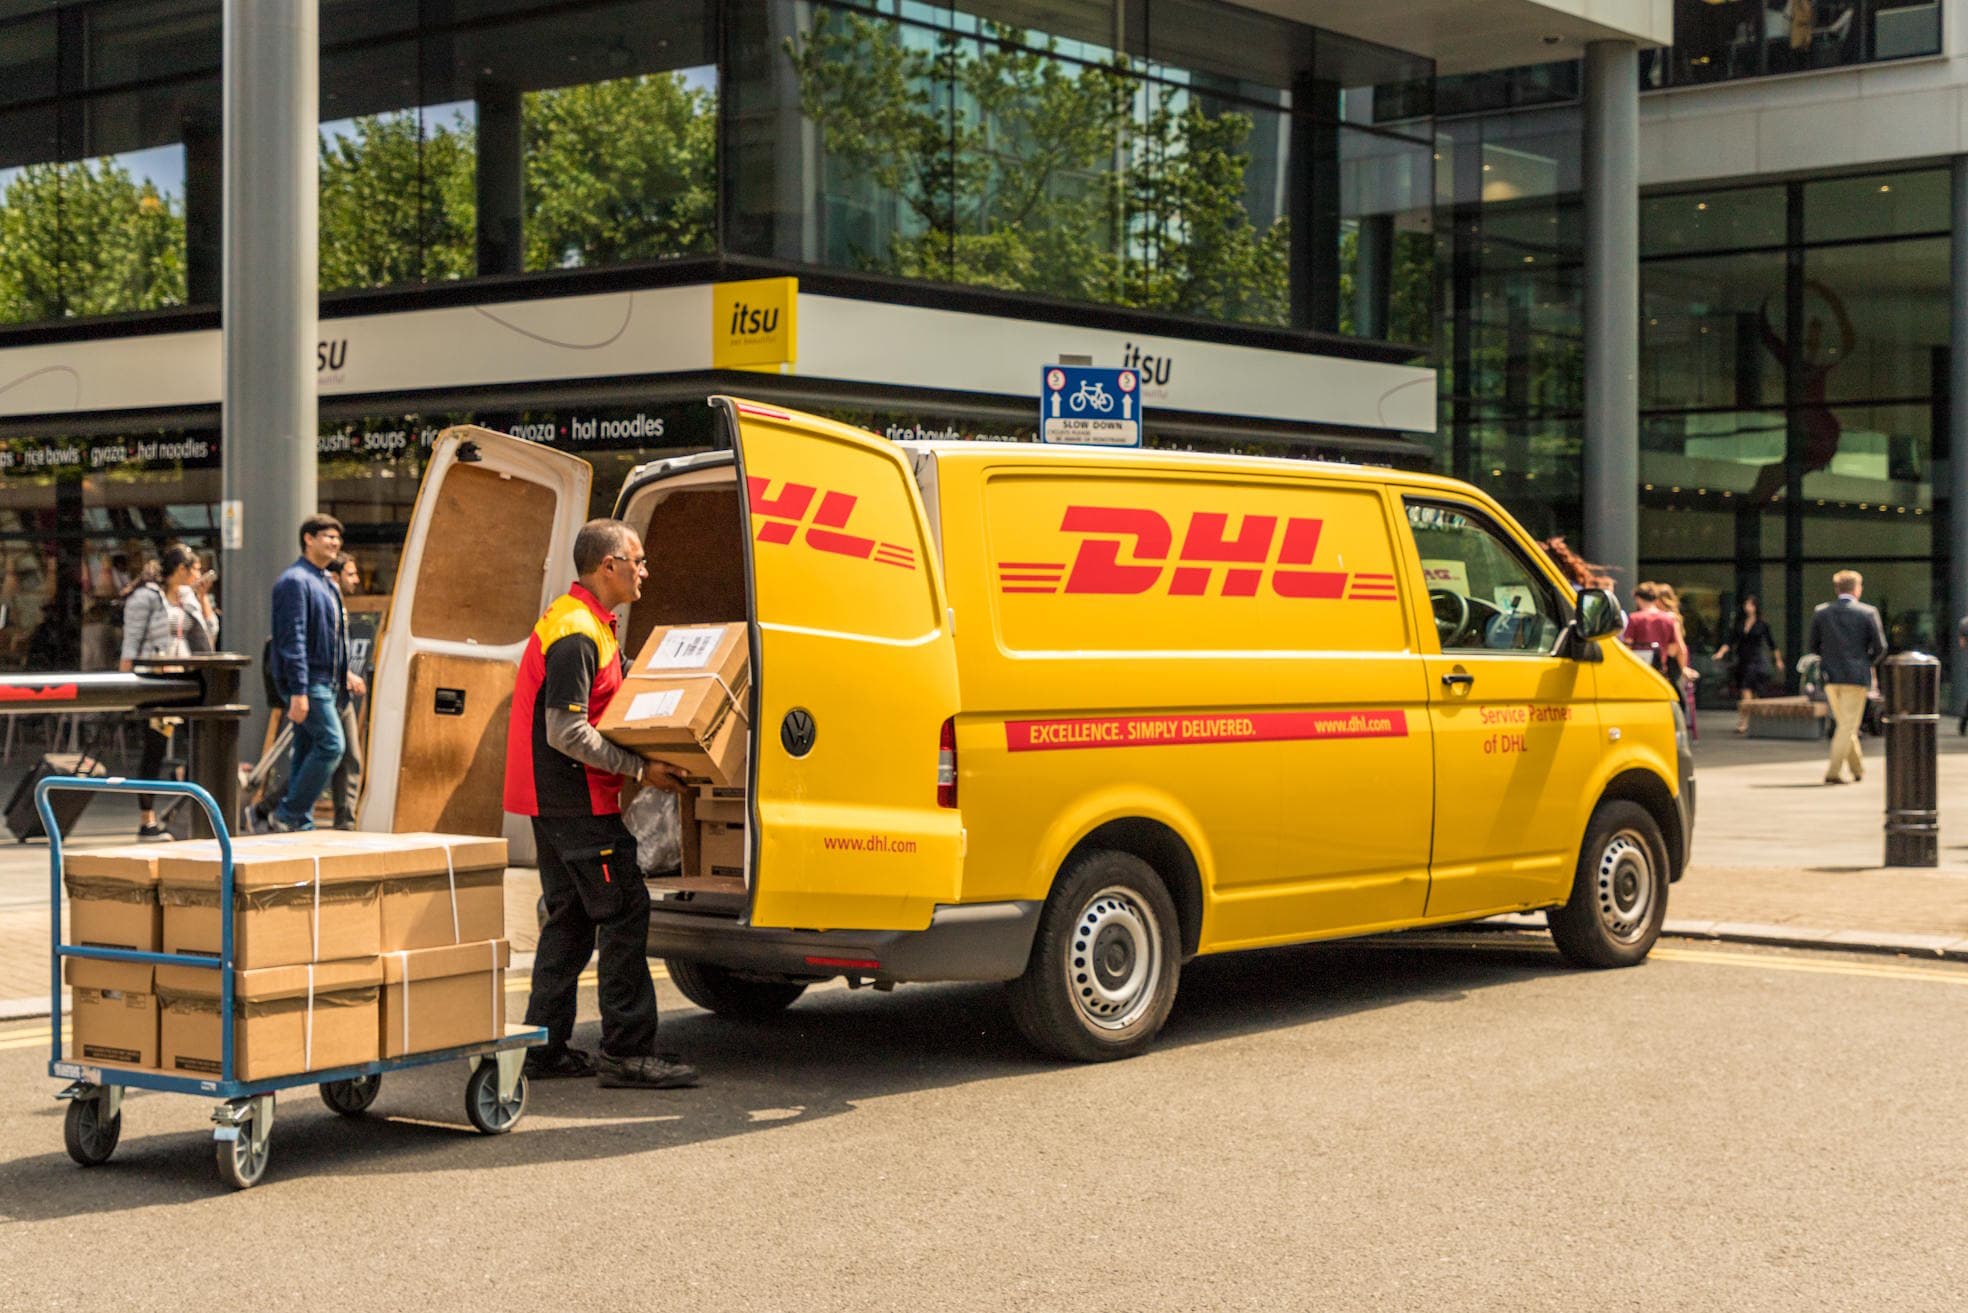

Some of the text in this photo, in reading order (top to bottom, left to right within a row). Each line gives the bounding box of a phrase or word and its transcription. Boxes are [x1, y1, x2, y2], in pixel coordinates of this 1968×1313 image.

[731, 301, 779, 336] itsu
[317, 339, 348, 372] su
[1124, 342, 1172, 385] itsu
[364, 431, 407, 452] soups
[421, 424, 438, 447] ric
[571, 416, 597, 440] hot
[600, 413, 664, 440] noodles
[1062, 420, 1123, 430] SLOW DOWN
[1059, 505, 1349, 600] DHL
[1314, 715, 1392, 734] www.dhl.com
[1479, 703, 1572, 725] Service Partner
[1029, 717, 1257, 744] EXCELLENCE. SIMPLY DELIVERED.
[1483, 734, 1528, 754] of DHL
[823, 835, 917, 853] www.dhl.com
